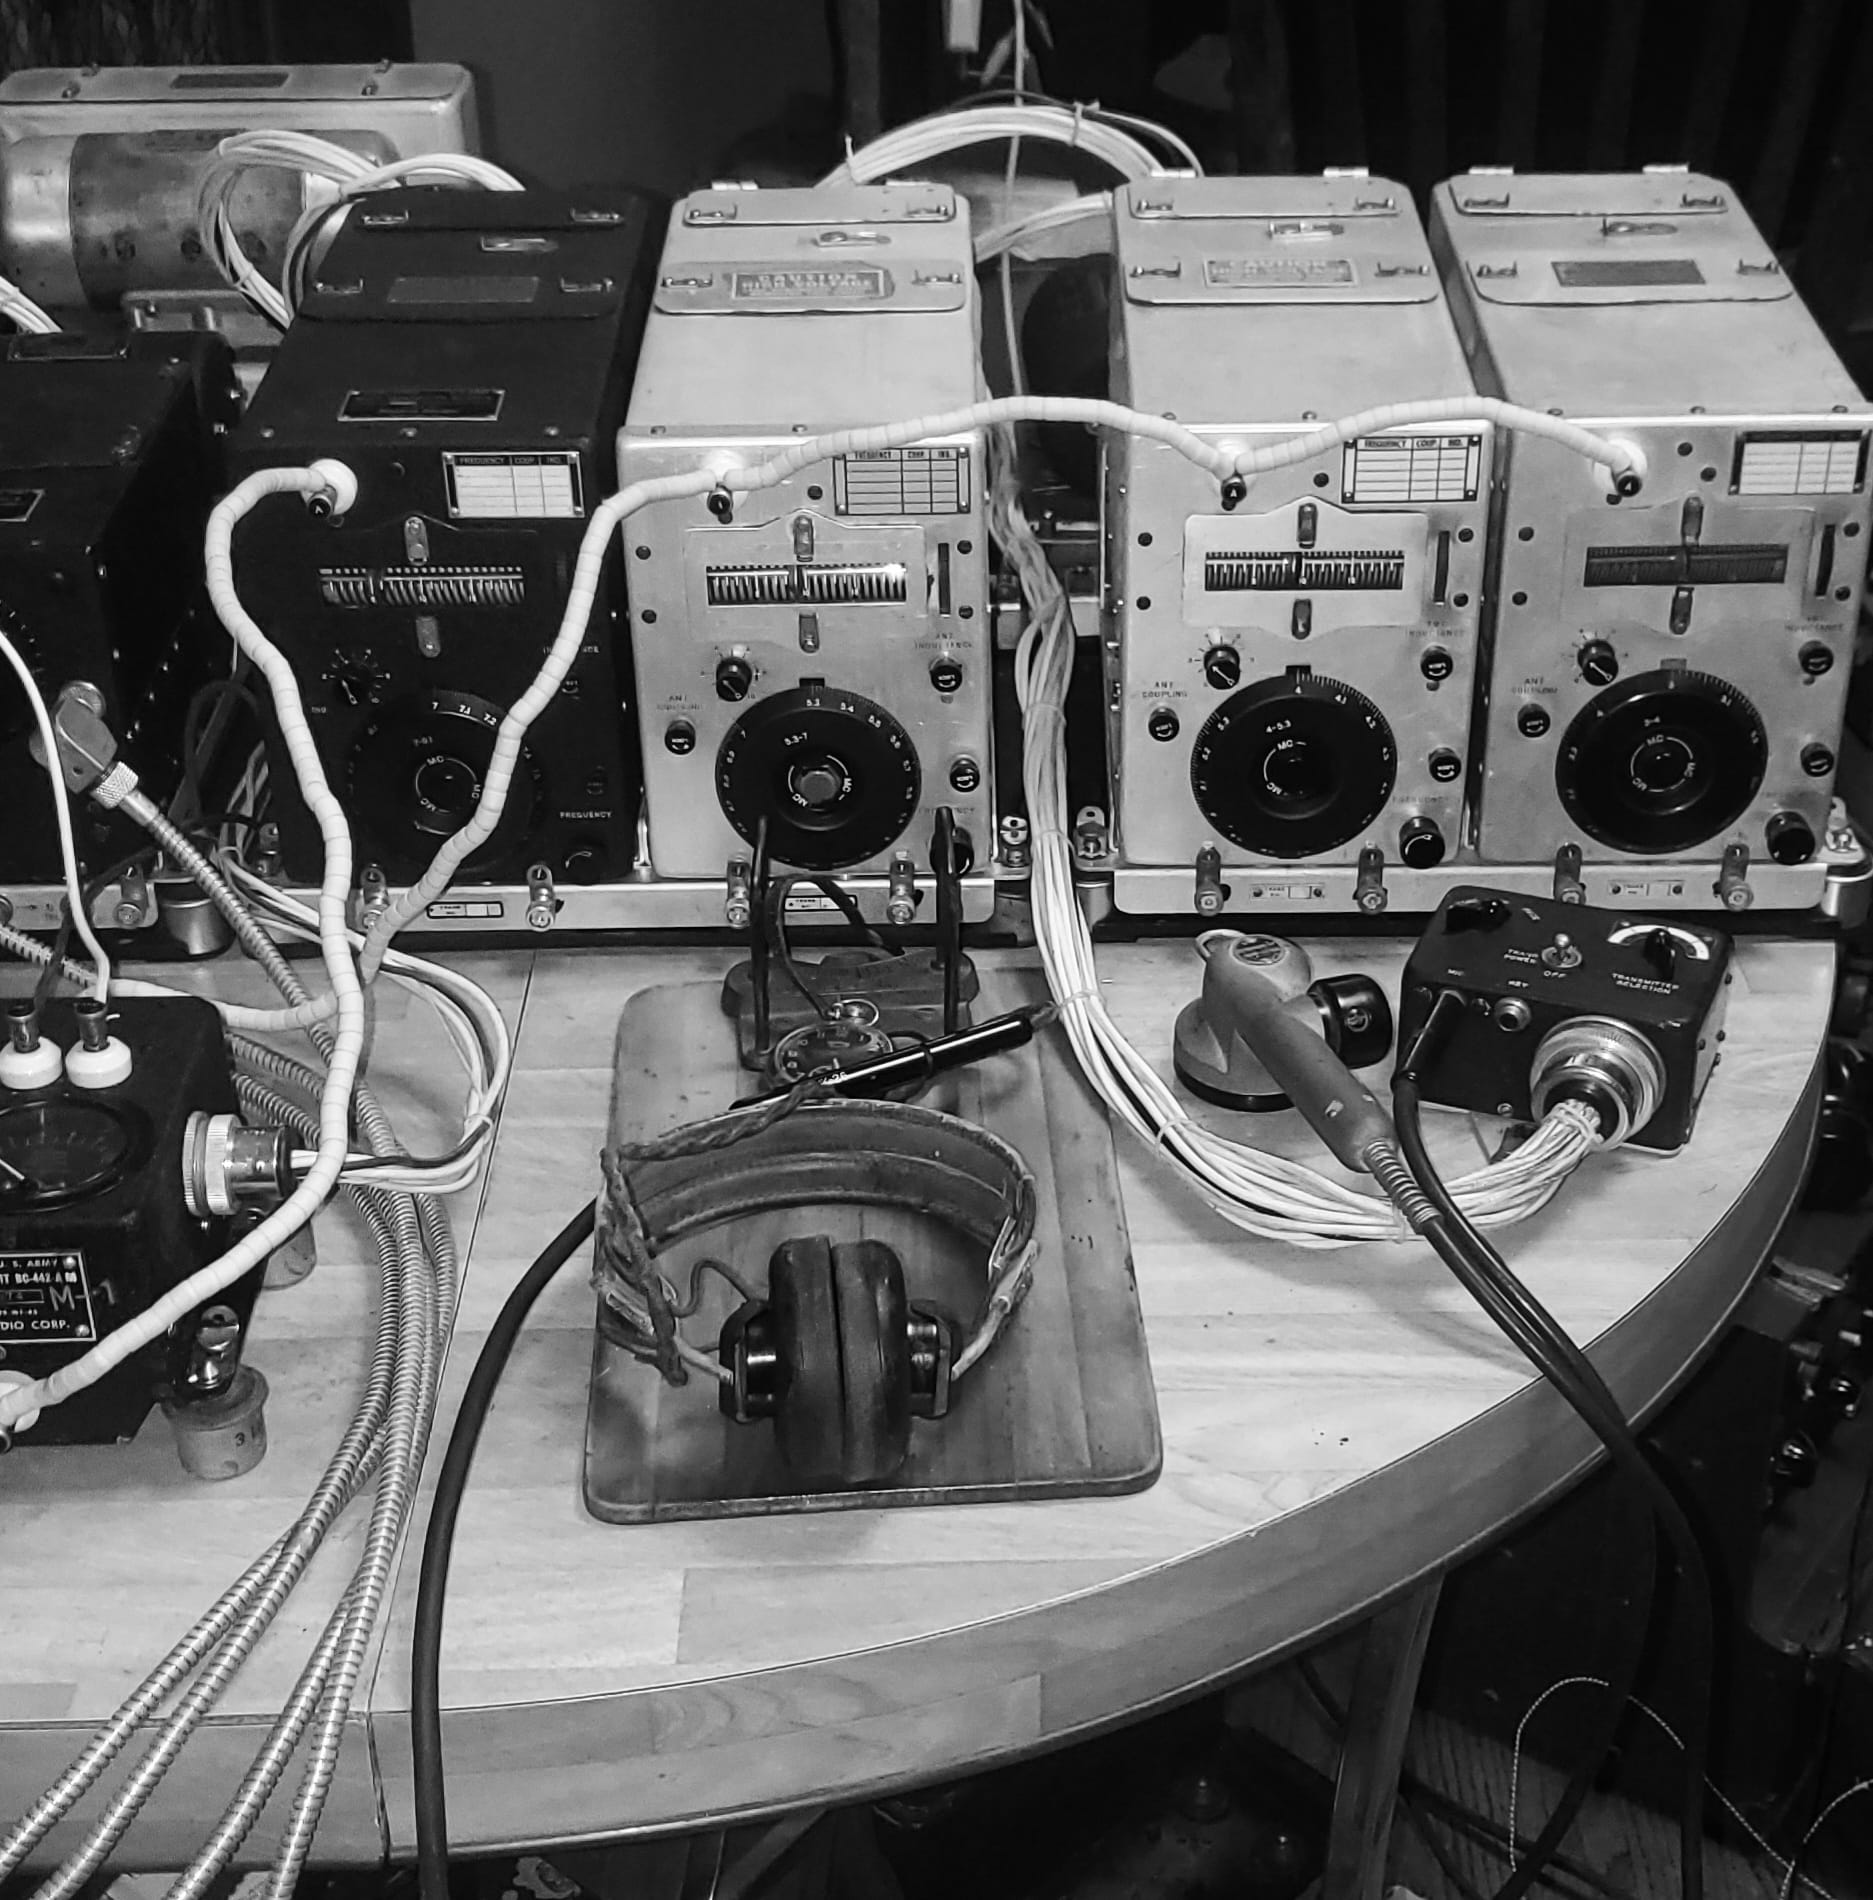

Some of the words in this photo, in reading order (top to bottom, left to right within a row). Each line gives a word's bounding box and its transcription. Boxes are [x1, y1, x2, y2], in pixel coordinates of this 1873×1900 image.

[1295, 685, 1303, 694] 4
[432, 701, 440, 711] 7
[806, 698, 821, 708] 5.3
[459, 704, 471, 716] 7.1
[483, 713, 498, 727] 7.2
[1265, 719, 1293, 734] 4-5.3
[784, 731, 809, 747] 5.3-7
[1277, 738, 1294, 751] MC
[1646, 733, 1665, 747] MC
[426, 755, 445, 766] MC
[1266, 781, 1284, 796] MC
[560, 810, 612, 819] FREQUENCY
[1543, 970, 1567, 978] OFF
[1612, 972, 1680, 990] TRANSMITTER
[1615, 980, 1672, 995] SELECTION
[26, 1259, 58, 1268] ARMY
[31, 1319, 71, 1331] CORP.
